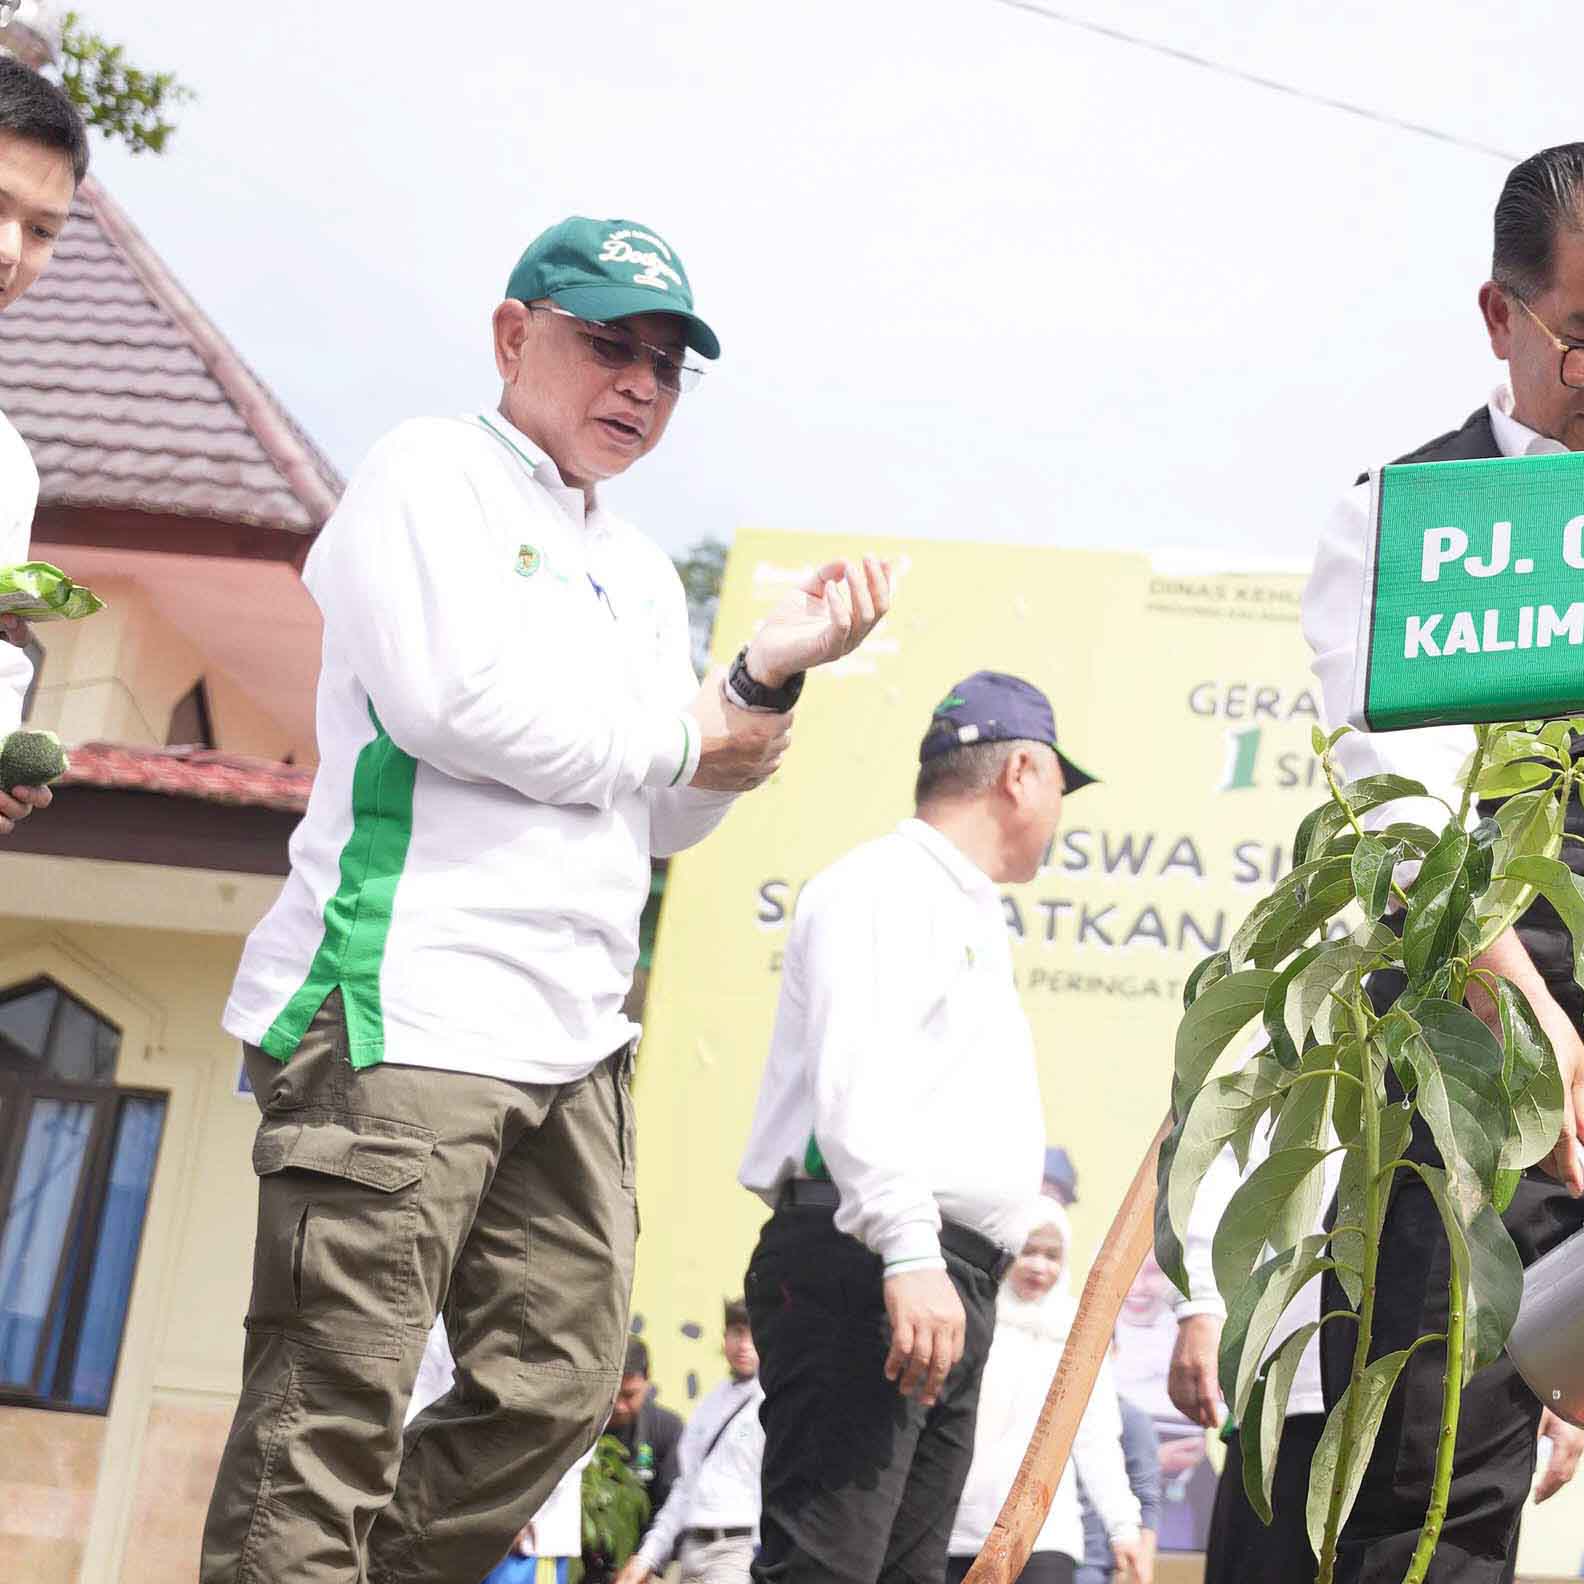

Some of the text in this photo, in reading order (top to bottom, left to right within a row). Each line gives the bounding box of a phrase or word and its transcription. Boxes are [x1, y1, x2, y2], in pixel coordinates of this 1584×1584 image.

[1420, 521, 1534, 582] PJ.
[1188, 680, 1320, 720] GERA
[1041, 828, 1207, 880] ISWA
[1029, 968, 1181, 1002] PERINGAT
